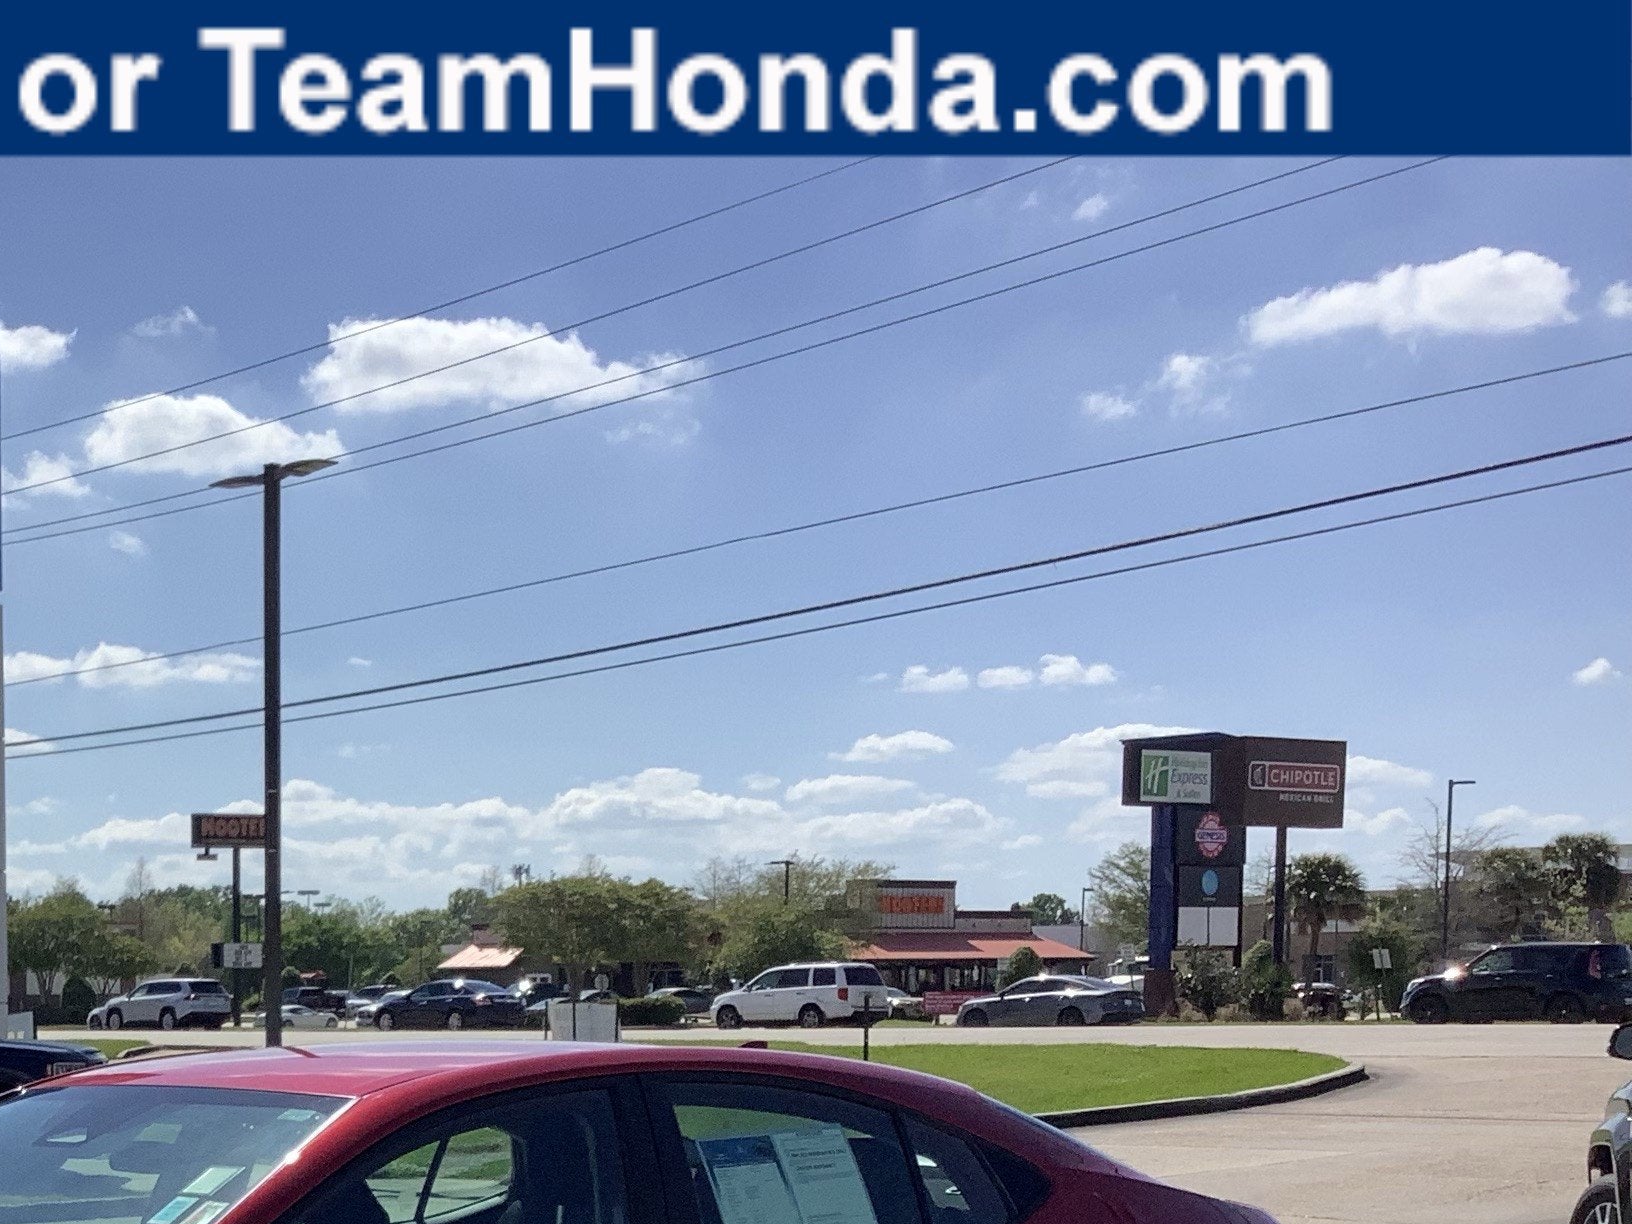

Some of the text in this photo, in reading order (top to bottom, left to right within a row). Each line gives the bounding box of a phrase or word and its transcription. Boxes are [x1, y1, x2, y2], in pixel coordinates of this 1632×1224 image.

[1171, 769, 1208, 786] Express
[1270, 769, 1336, 786] CHIPOTLE
[201, 817, 266, 838] HOOTE
